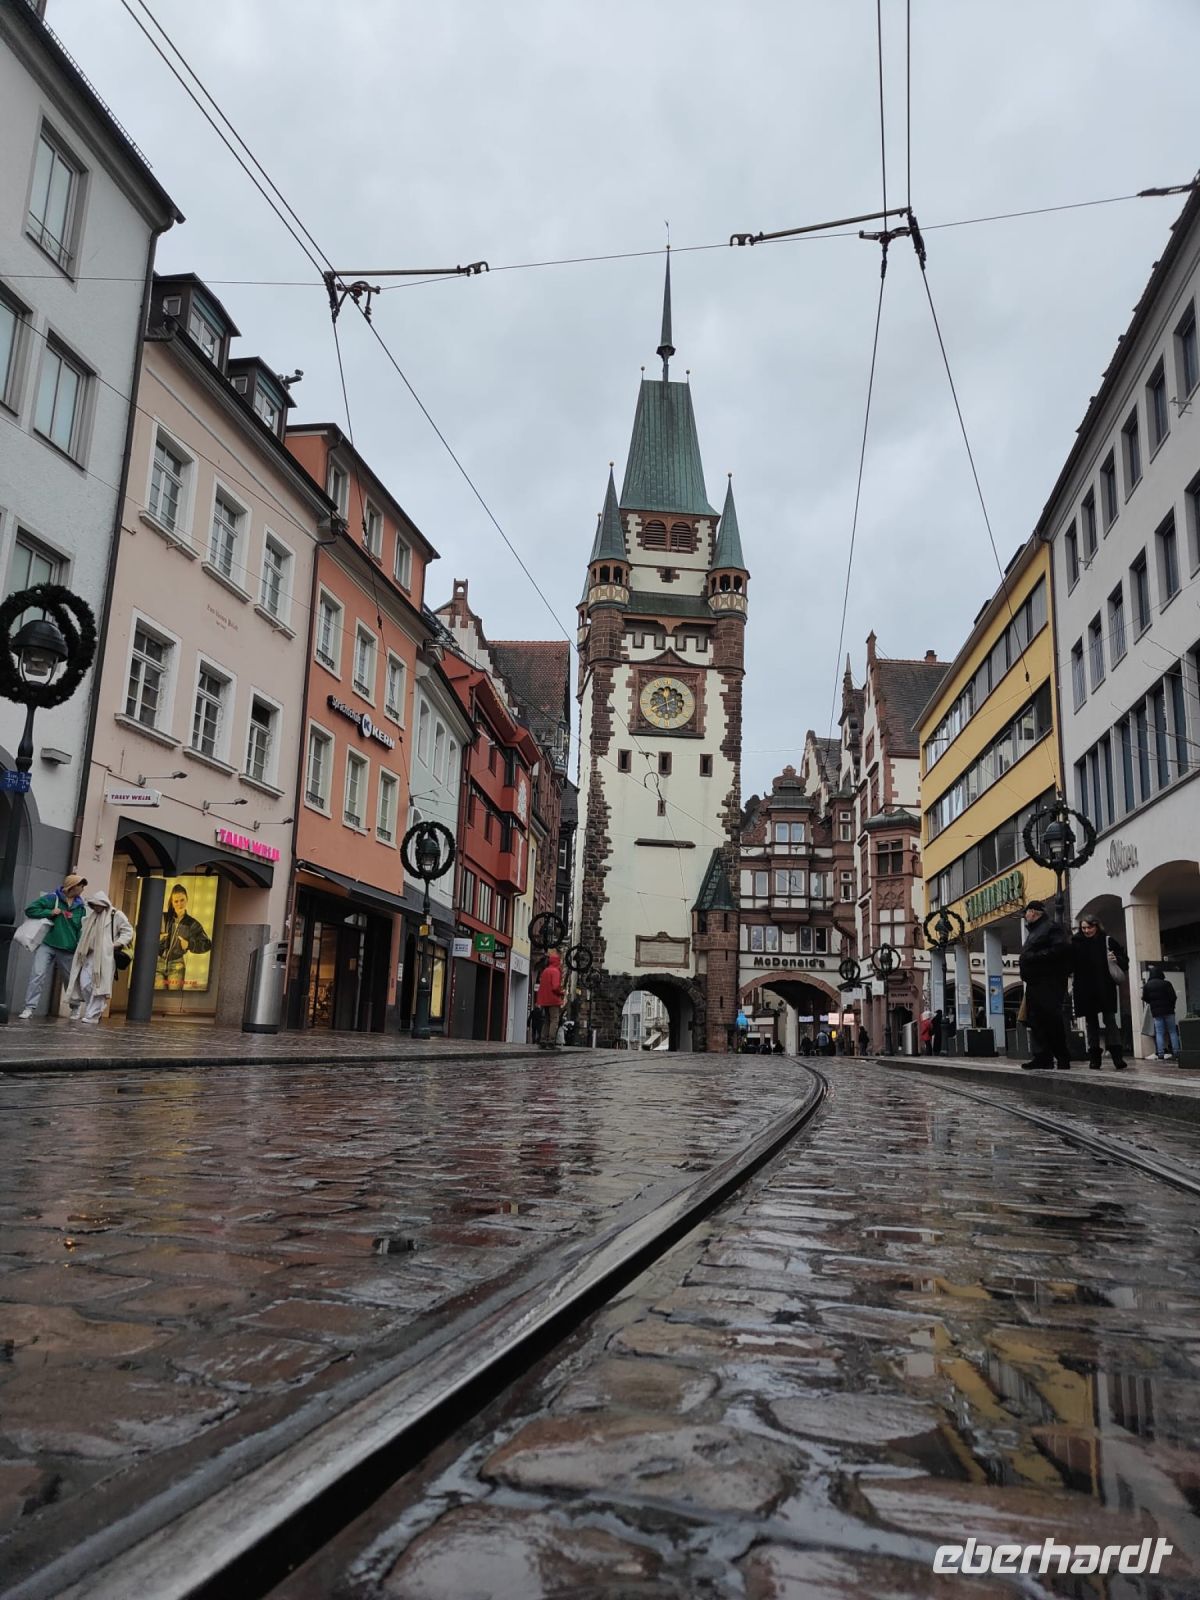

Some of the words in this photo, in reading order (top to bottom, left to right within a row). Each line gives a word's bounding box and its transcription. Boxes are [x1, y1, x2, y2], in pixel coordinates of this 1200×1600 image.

[372, 725, 396, 750] KERN
[217, 827, 250, 851] TALLY
[753, 956, 826, 969] McDonald's
